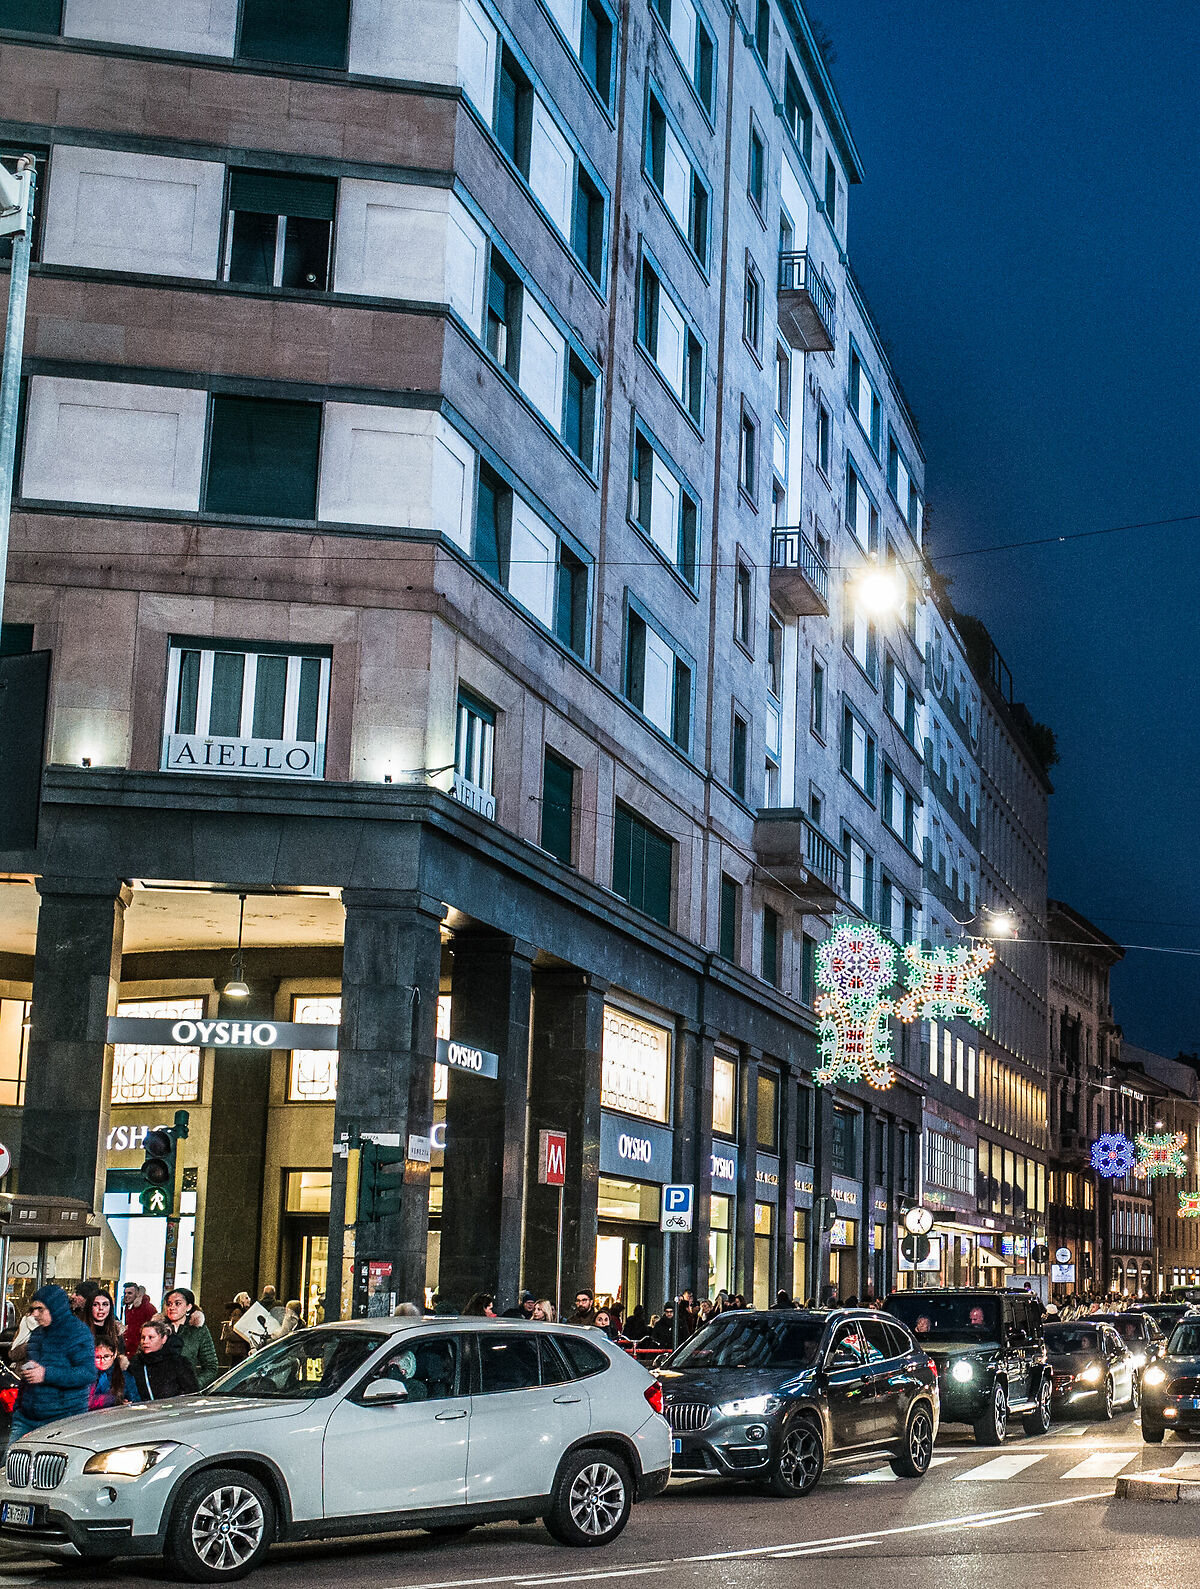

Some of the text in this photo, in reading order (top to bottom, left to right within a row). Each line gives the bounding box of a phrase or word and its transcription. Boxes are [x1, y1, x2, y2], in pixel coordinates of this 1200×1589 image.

[172, 741, 311, 771] AIELLO
[171, 1020, 279, 1046] OYSHO
[447, 1045, 483, 1072] OYSHO
[106, 1124, 169, 1152] YSH
[617, 1133, 652, 1163] OYSHO
[548, 1144, 564, 1175] M
[669, 1190, 685, 1210] P
